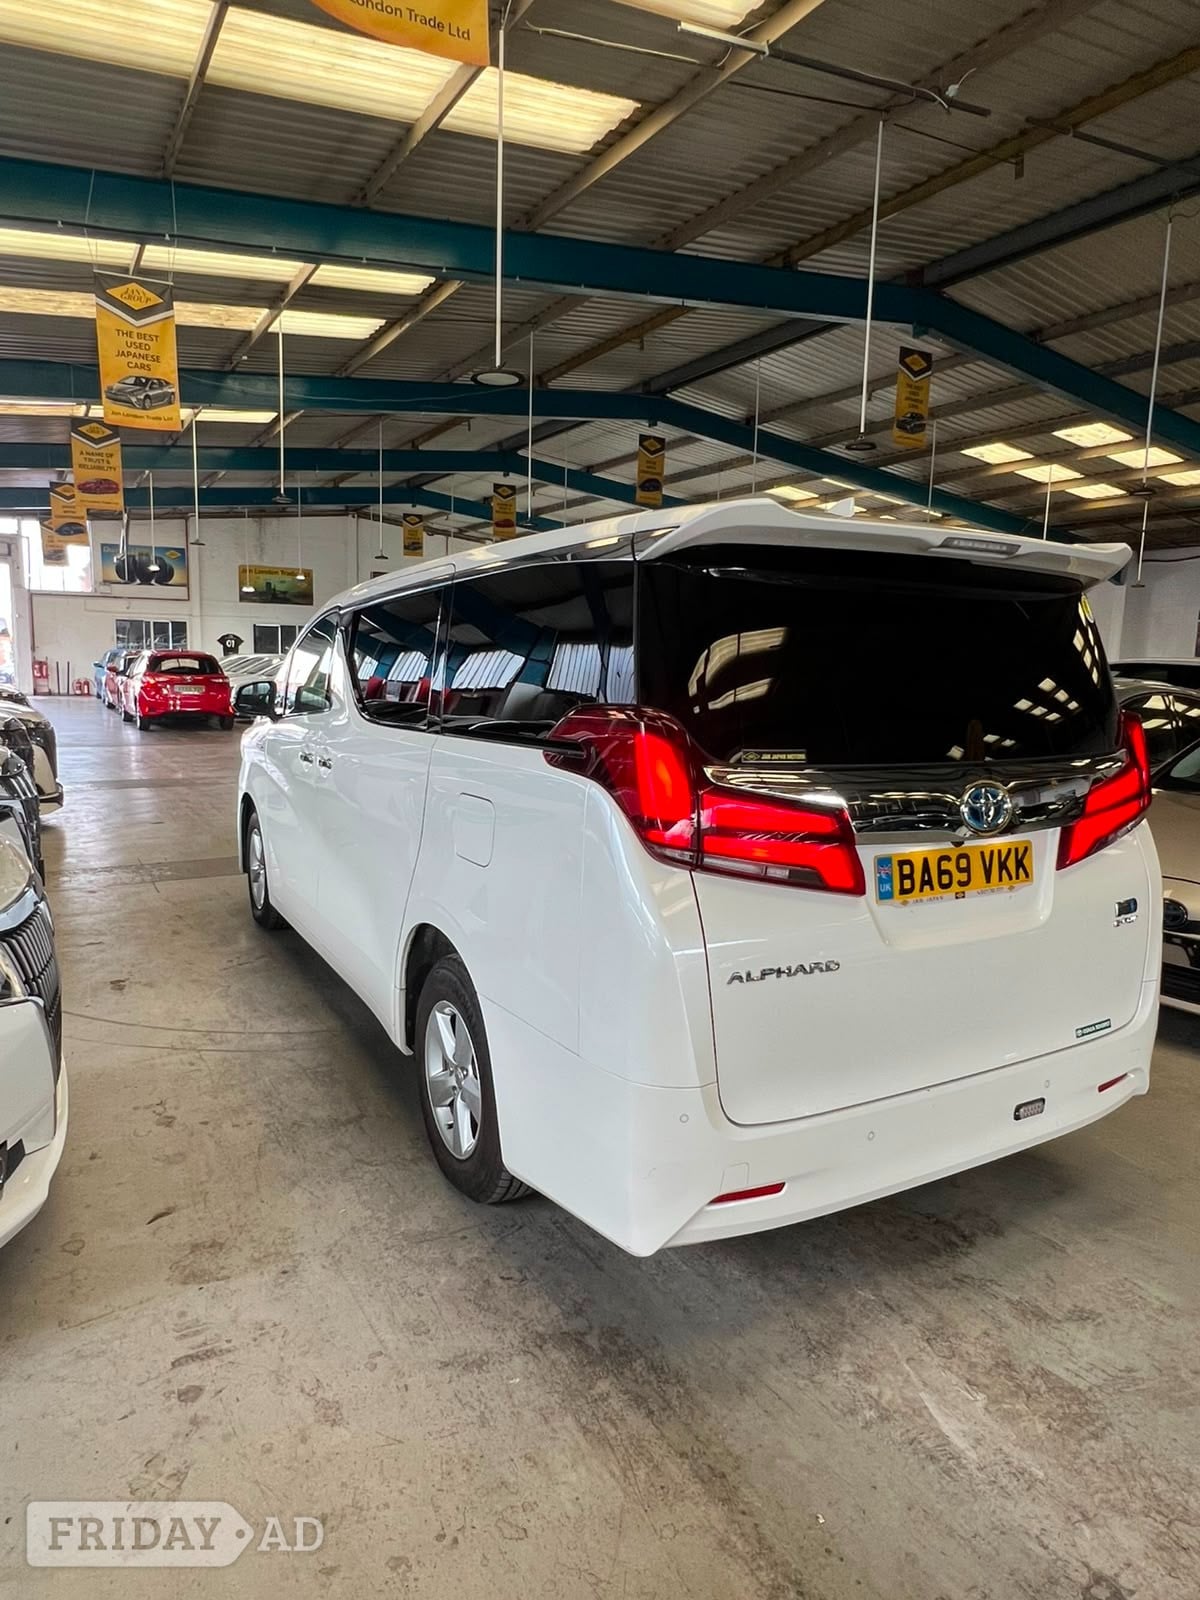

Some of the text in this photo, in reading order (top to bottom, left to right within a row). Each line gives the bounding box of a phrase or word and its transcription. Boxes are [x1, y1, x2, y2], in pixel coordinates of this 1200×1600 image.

[350, 0, 471, 41] ondon Trade Ltd
[115, 329, 160, 342] THE BEST
[125, 341, 151, 351] USED
[115, 350, 161, 363] JAPANESE
[127, 361, 152, 371] CARS
[226, 640, 235, 648] 01
[897, 846, 1030, 895] BA69 VKK
[879, 883, 892, 893] UK
[726, 960, 840, 985] ALPHARD
